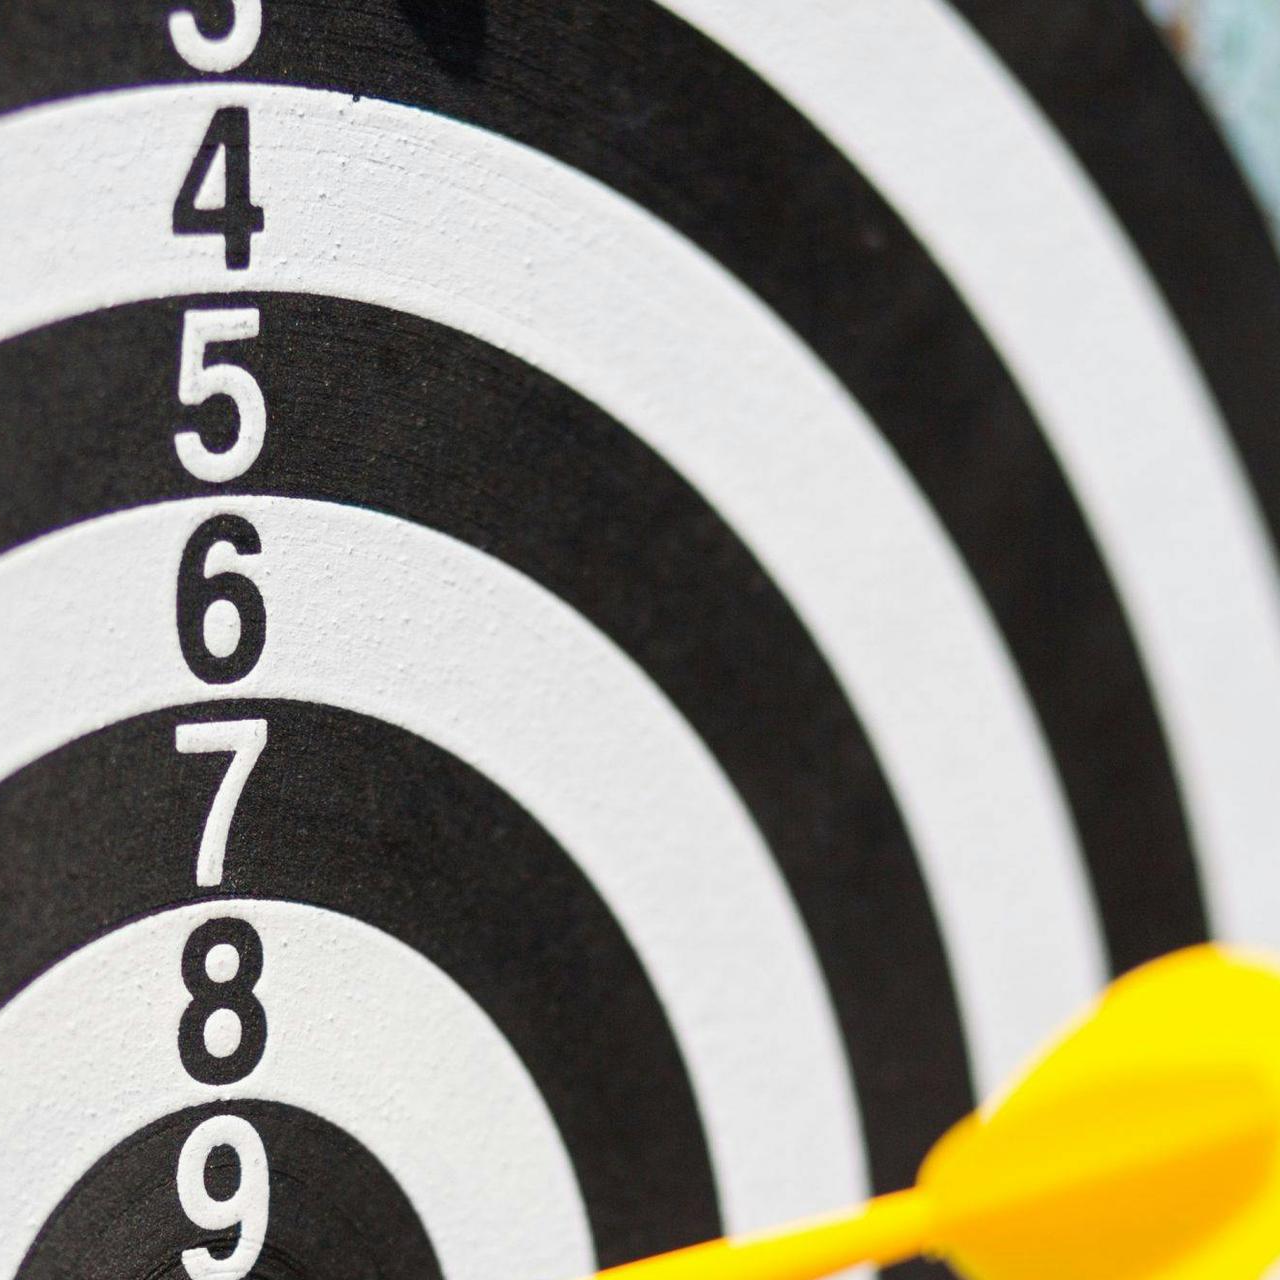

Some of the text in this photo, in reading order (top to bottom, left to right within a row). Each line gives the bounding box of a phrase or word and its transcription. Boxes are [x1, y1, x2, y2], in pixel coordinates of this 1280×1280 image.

[171, 104, 265, 271] 4
[173, 307, 267, 483] 5
[175, 512, 267, 685] 6
[175, 718, 268, 887] 7
[177, 915, 268, 1087] 8
